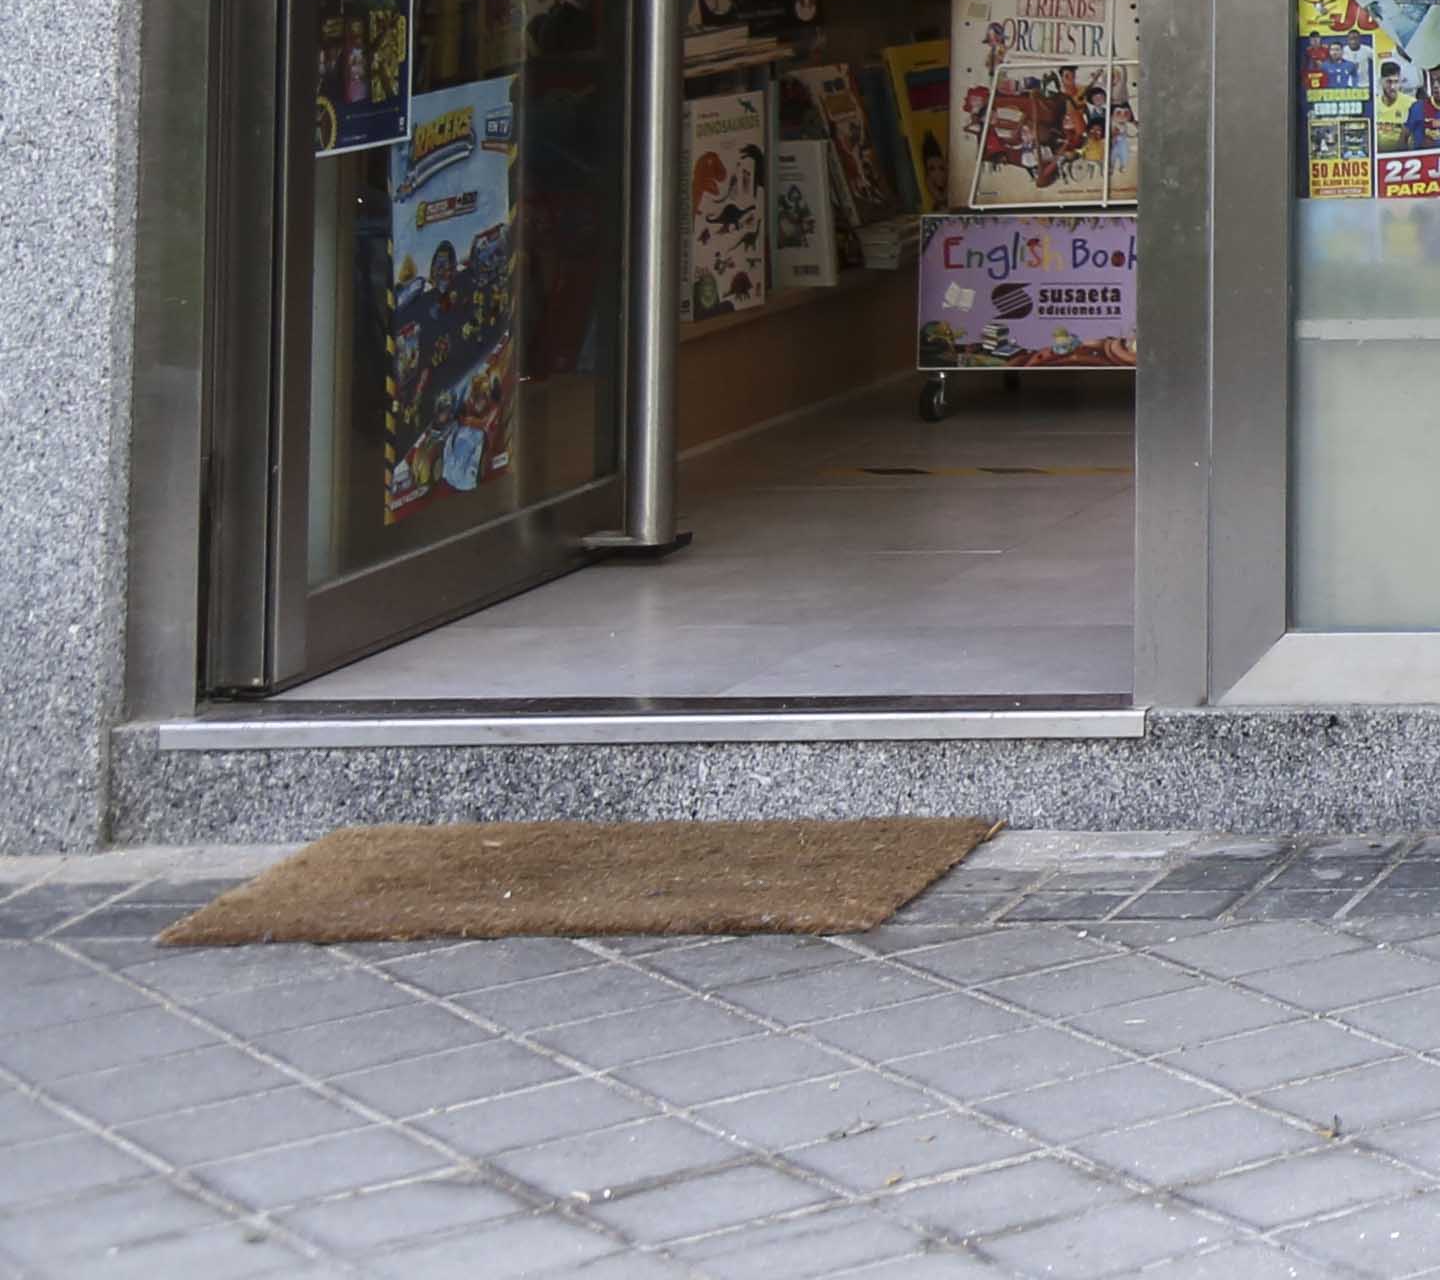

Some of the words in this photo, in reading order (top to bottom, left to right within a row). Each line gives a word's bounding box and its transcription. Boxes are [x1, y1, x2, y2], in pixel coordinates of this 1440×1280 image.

[1311, 159, 1330, 178] 50
[1386, 158, 1422, 182] 22
[943, 231, 1065, 280] English
[1038, 286, 1122, 303] susaeta
[1038, 304, 1103, 316] ediciones
